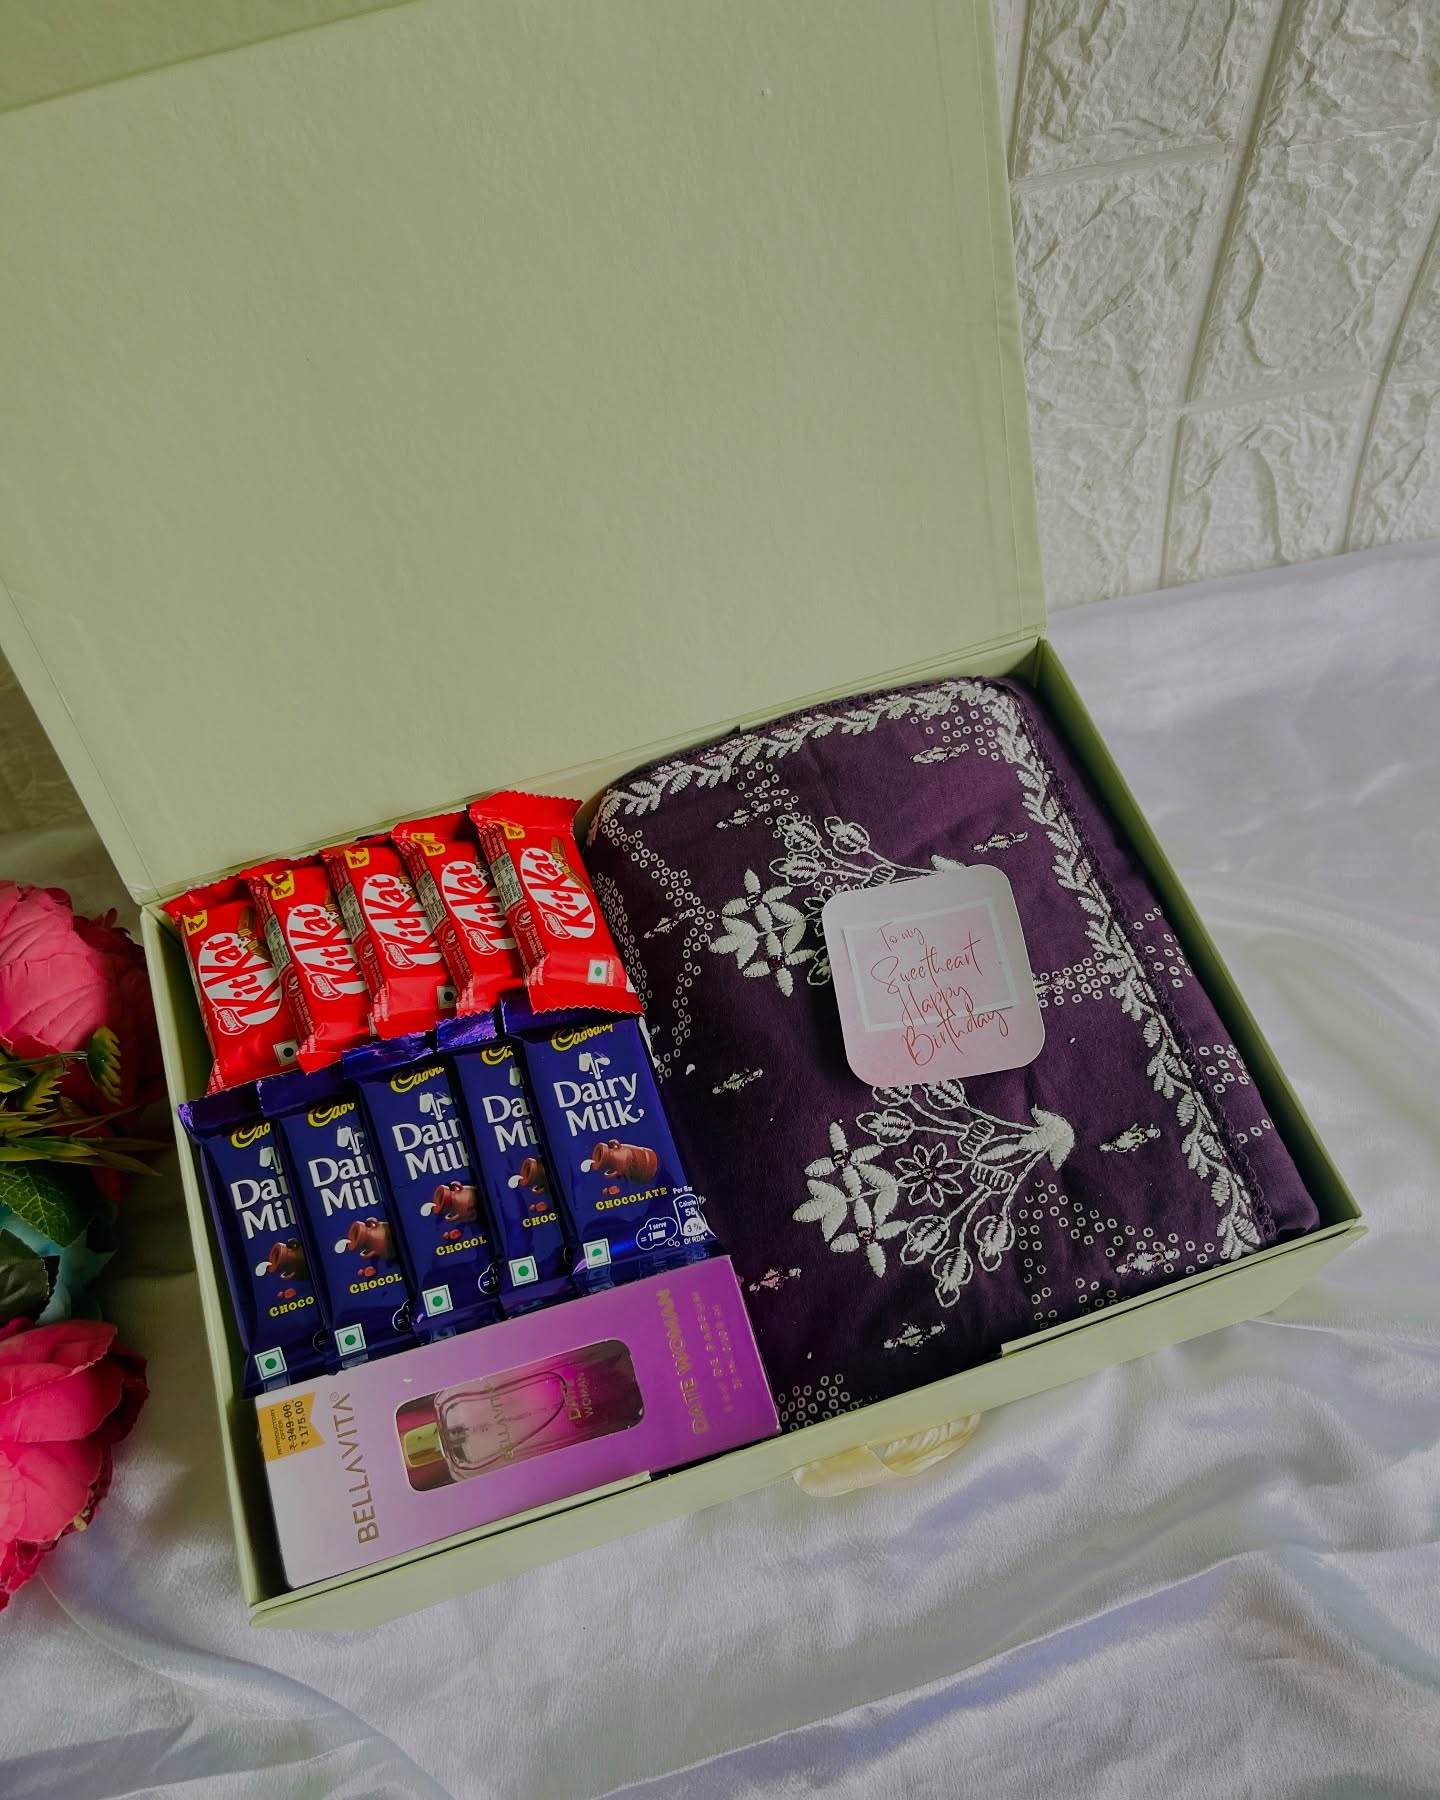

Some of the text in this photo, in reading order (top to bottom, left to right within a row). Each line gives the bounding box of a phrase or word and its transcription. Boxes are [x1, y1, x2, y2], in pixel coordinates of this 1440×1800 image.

[870, 931, 983, 994] Sweetheart
[901, 984, 974, 1027] Happy
[902, 1004, 1009, 1066] Birthday
[553, 1073, 638, 1109] Dairy
[565, 1100, 645, 1137] Milk
[595, 1186, 668, 1211] CHOCOLATE
[269, 1296, 315, 1317] CHOCO
[656, 1288, 710, 1434] DATE WOMAN
[294, 1400, 309, 1437] 175.00
